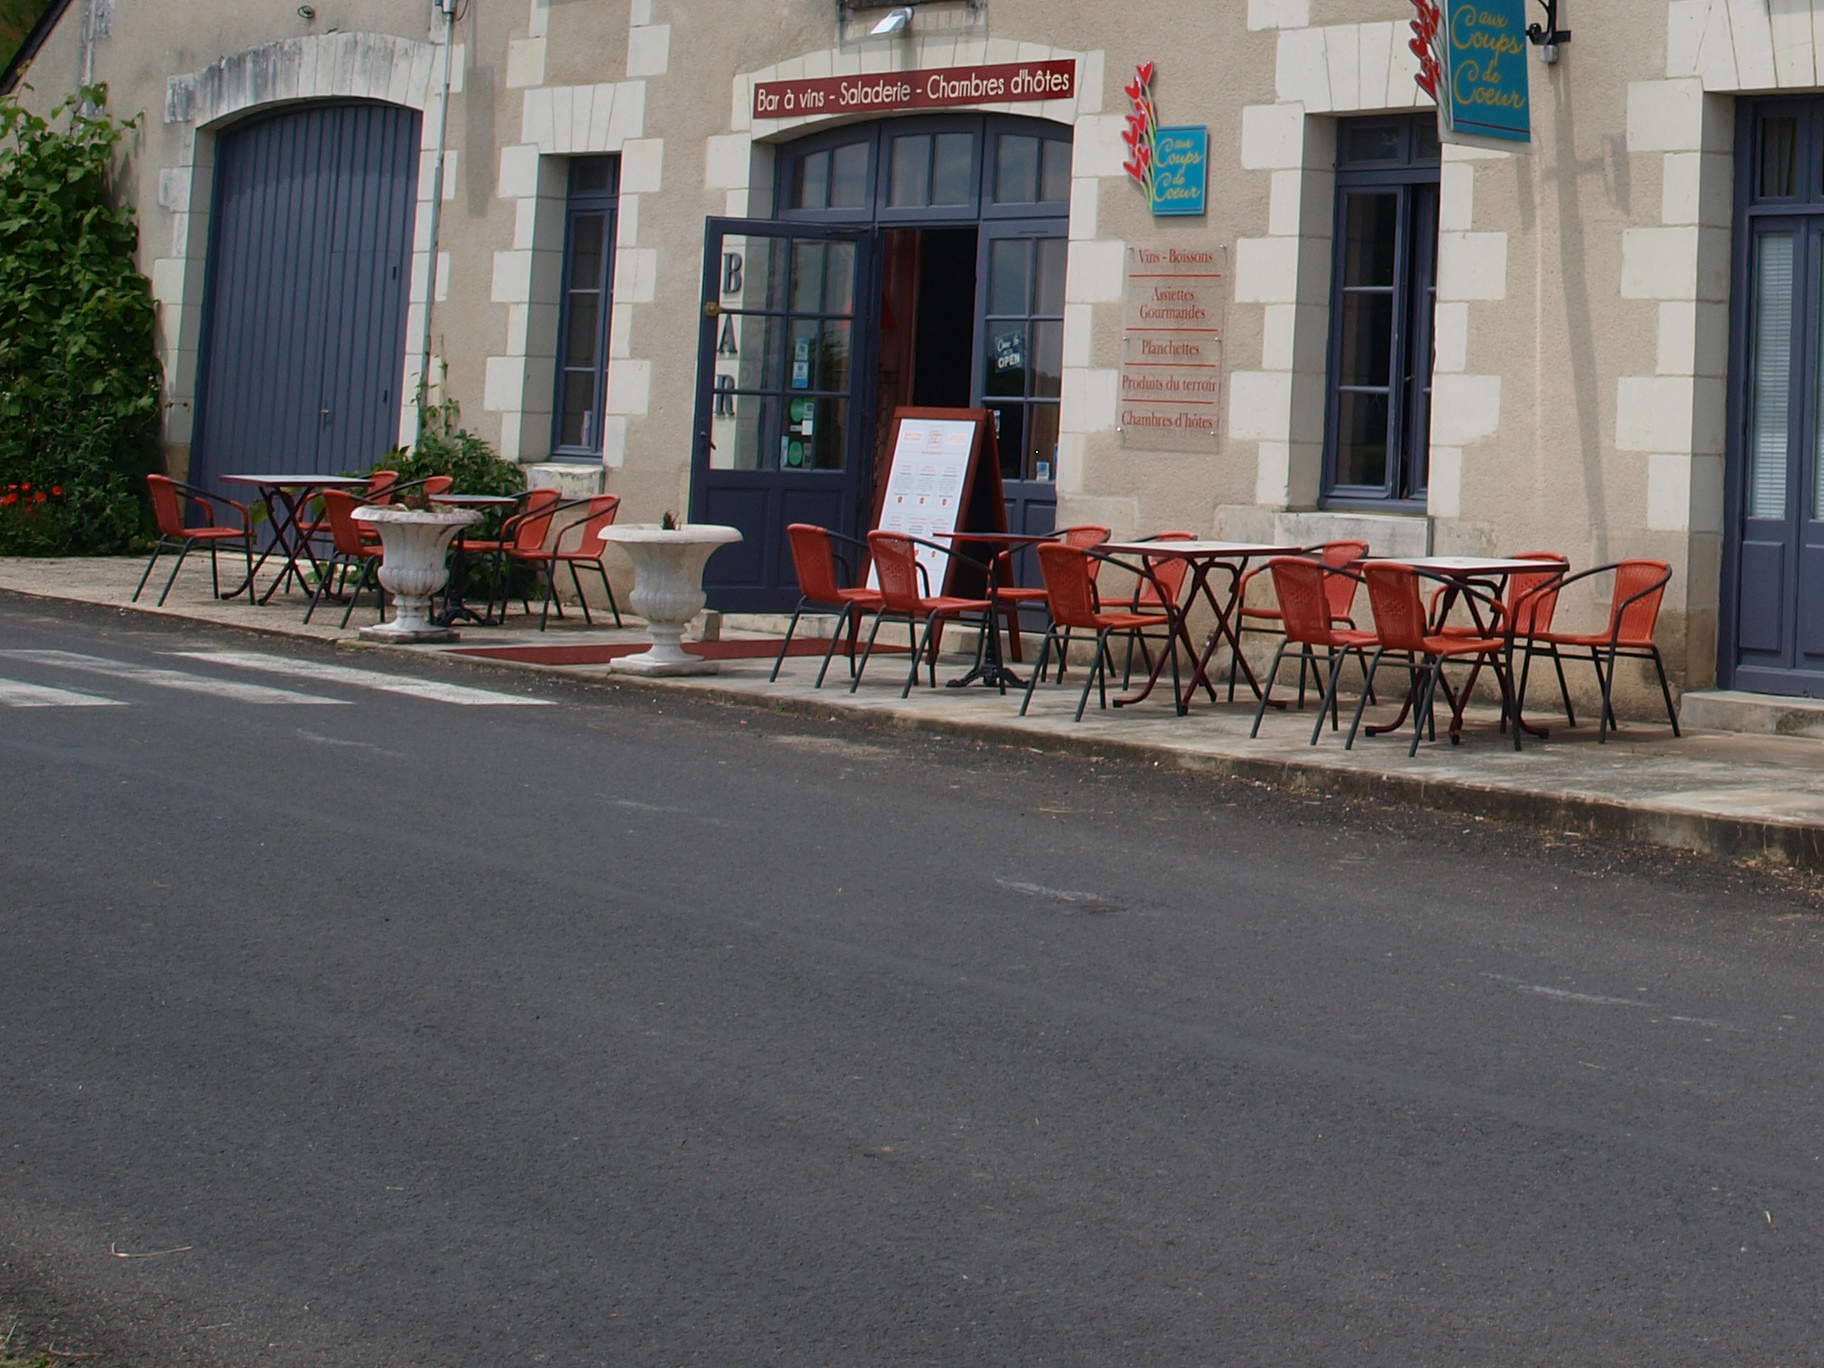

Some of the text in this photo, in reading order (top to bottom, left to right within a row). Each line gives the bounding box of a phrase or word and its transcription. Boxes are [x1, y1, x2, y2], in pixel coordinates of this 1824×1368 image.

[1479, 11, 1509, 28] aux
[1452, 4, 1524, 66] Coups
[1483, 59, 1502, 83] de
[757, 88, 778, 112] Bar
[784, 89, 795, 110] à
[800, 87, 825, 109] vins
[839, 82, 911, 106] Saladerie
[927, 73, 1005, 99] Chambres
[1010, 69, 1070, 95] d'hôtes
[1454, 59, 1526, 109] Coeur
[1156, 138, 1204, 169] Coups
[1137, 248, 1160, 264] Vins
[1169, 248, 1213, 264] Boissons
[1152, 286, 1195, 301] Assiettes
[1139, 304, 1206, 320] Gourmandes
[713, 252, 743, 417] BAR
[1142, 339, 1200, 356] Planchettes
[998, 352, 1021, 369] OPEN
[1121, 375, 1217, 392] Produits du terroir
[1121, 410, 1213, 429] Chambres d'hôtes
